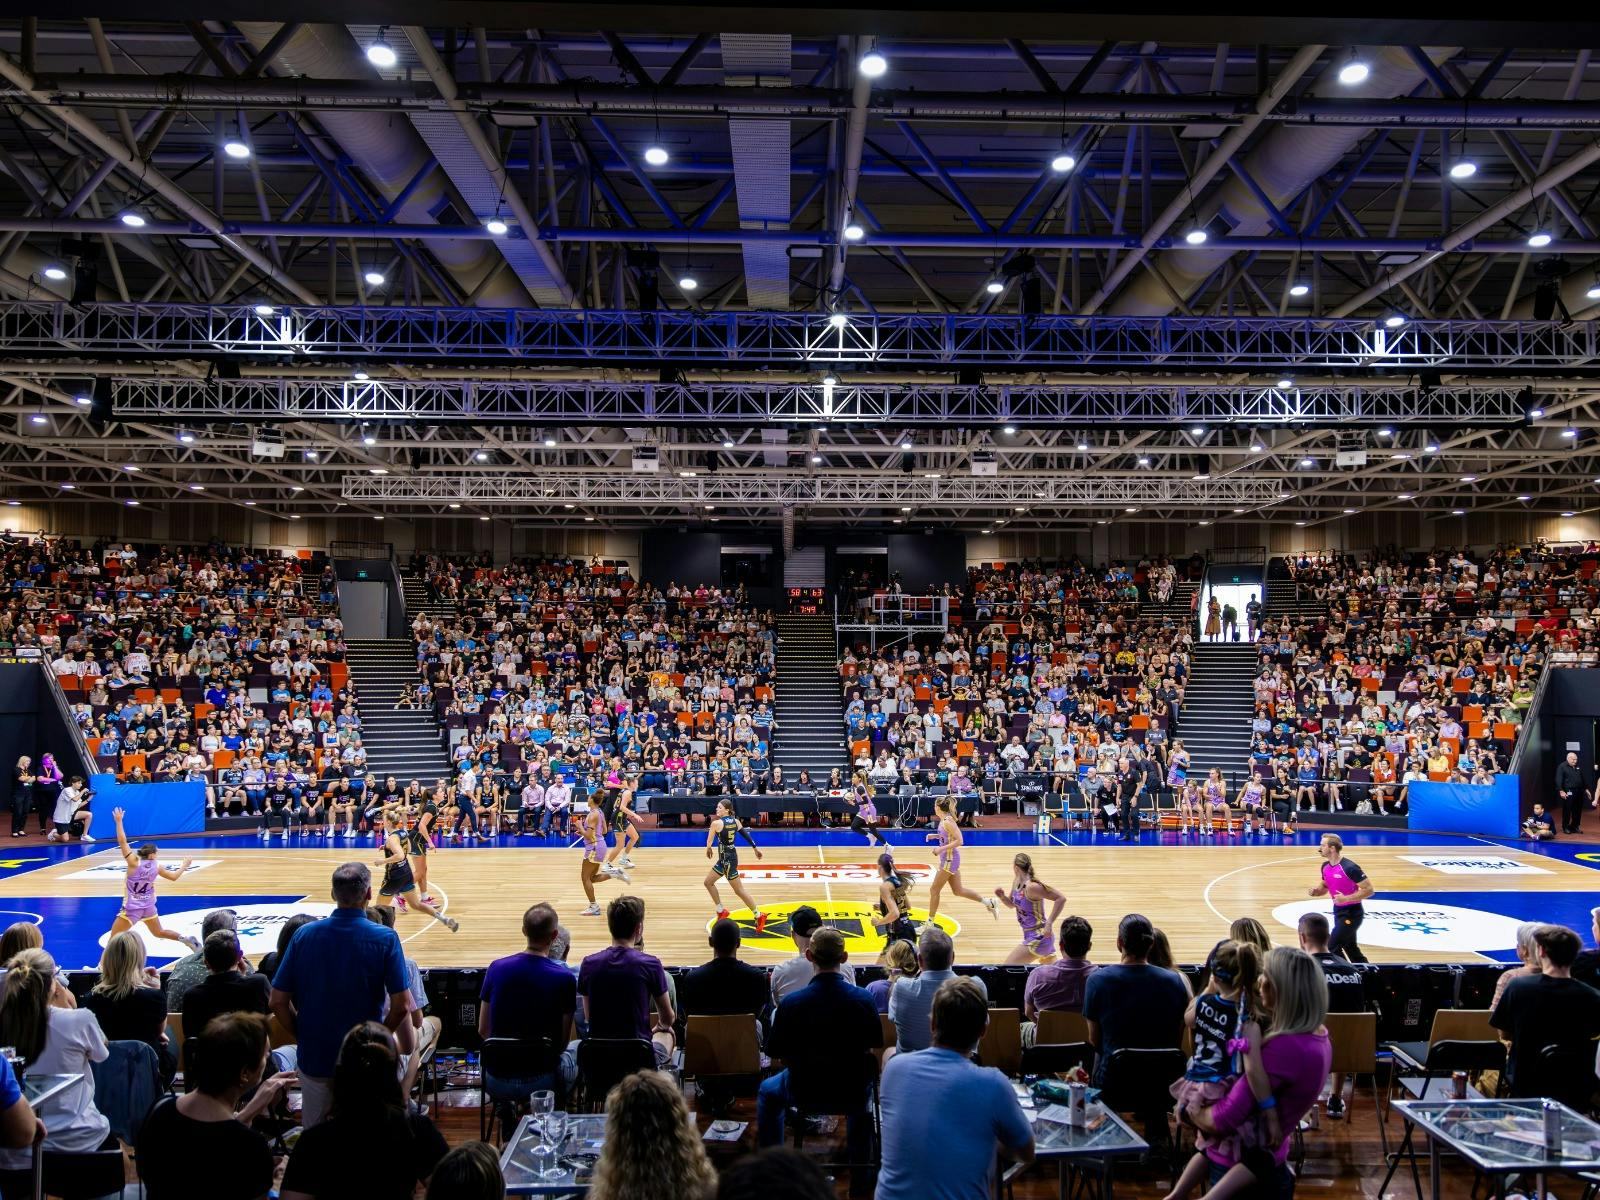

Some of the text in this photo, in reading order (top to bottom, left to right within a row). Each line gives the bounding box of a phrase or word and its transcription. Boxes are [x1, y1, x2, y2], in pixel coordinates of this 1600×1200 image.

[728, 830, 736, 843] 5
[133, 881, 152, 895] 14
[1200, 1002, 1228, 1025] TOLO
